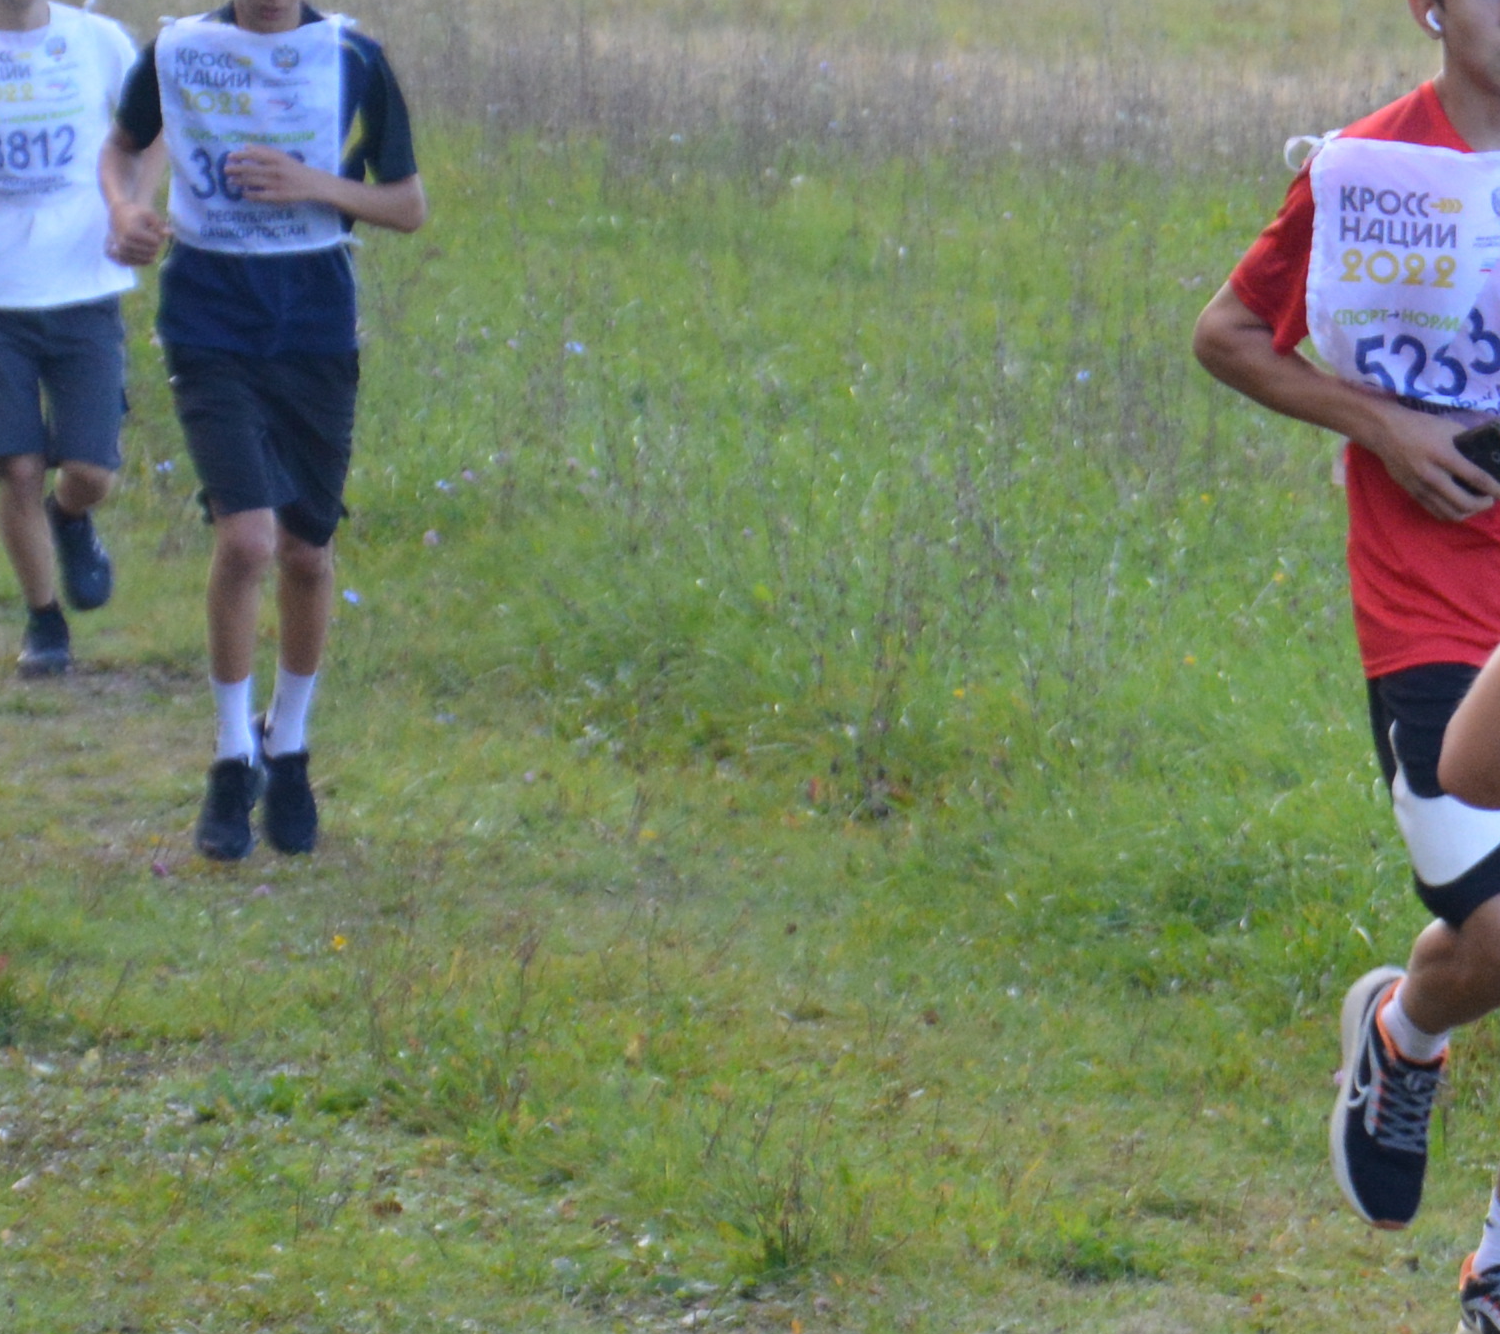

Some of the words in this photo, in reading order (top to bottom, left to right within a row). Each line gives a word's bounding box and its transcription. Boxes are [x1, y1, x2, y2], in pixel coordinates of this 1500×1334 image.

[1339, 185, 1430, 218] КРОСС
[1339, 216, 1457, 249] НАЦИИ
[1338, 248, 1457, 288] 2022
[1334, 309, 1389, 326] СПОРТ
